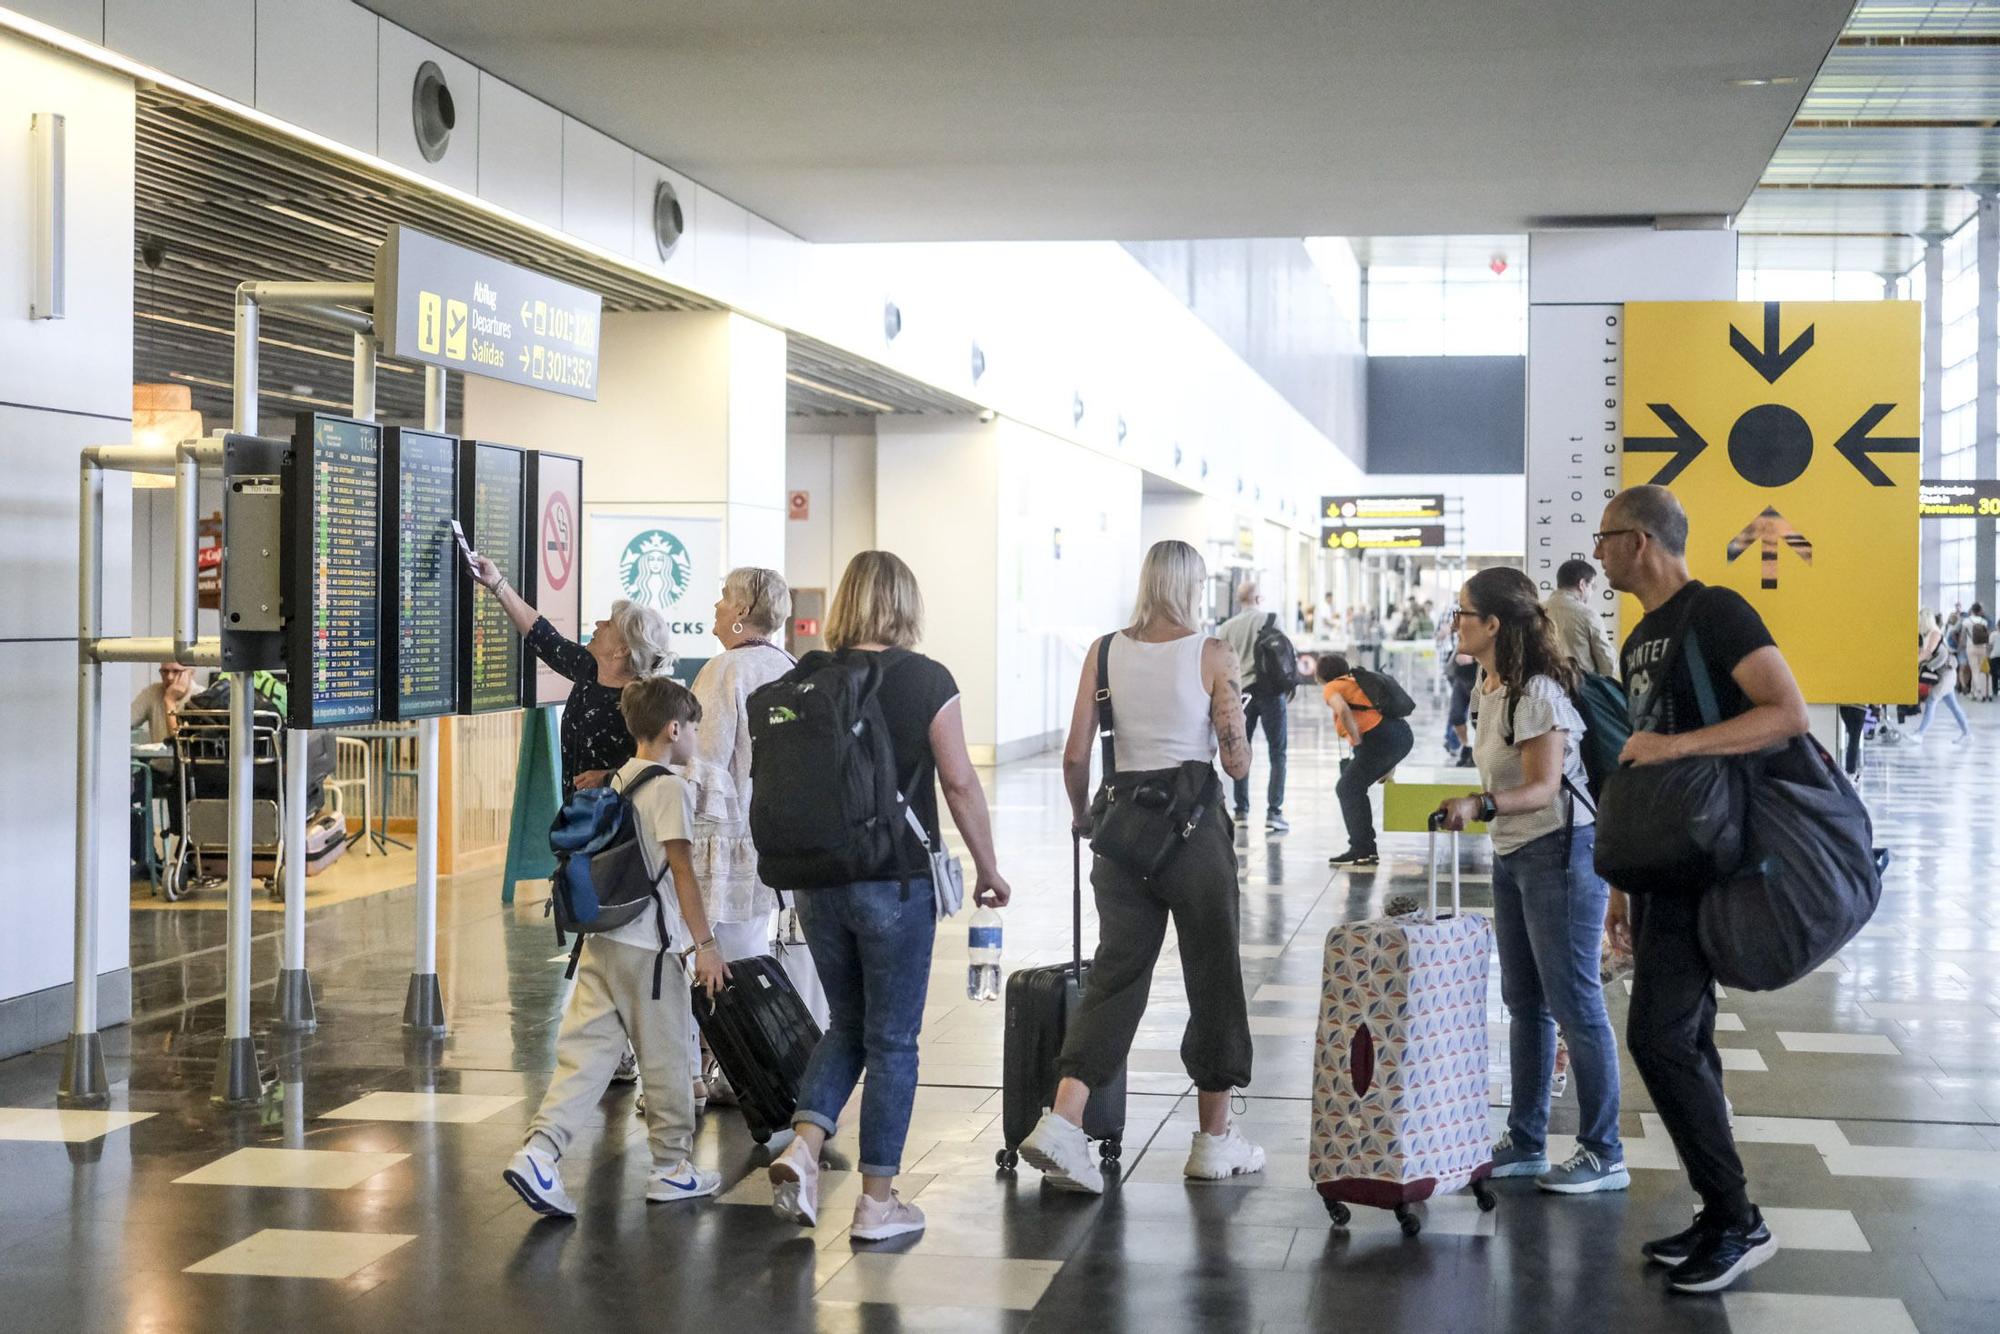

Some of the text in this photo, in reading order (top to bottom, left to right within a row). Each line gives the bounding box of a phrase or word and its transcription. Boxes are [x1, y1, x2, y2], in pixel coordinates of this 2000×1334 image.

[473, 280, 496, 311] Abflug
[472, 309, 511, 339] Departures
[472, 338, 504, 367] Salidas
[1603, 315, 1617, 499] encuentro
[1568, 435, 1585, 523] point
